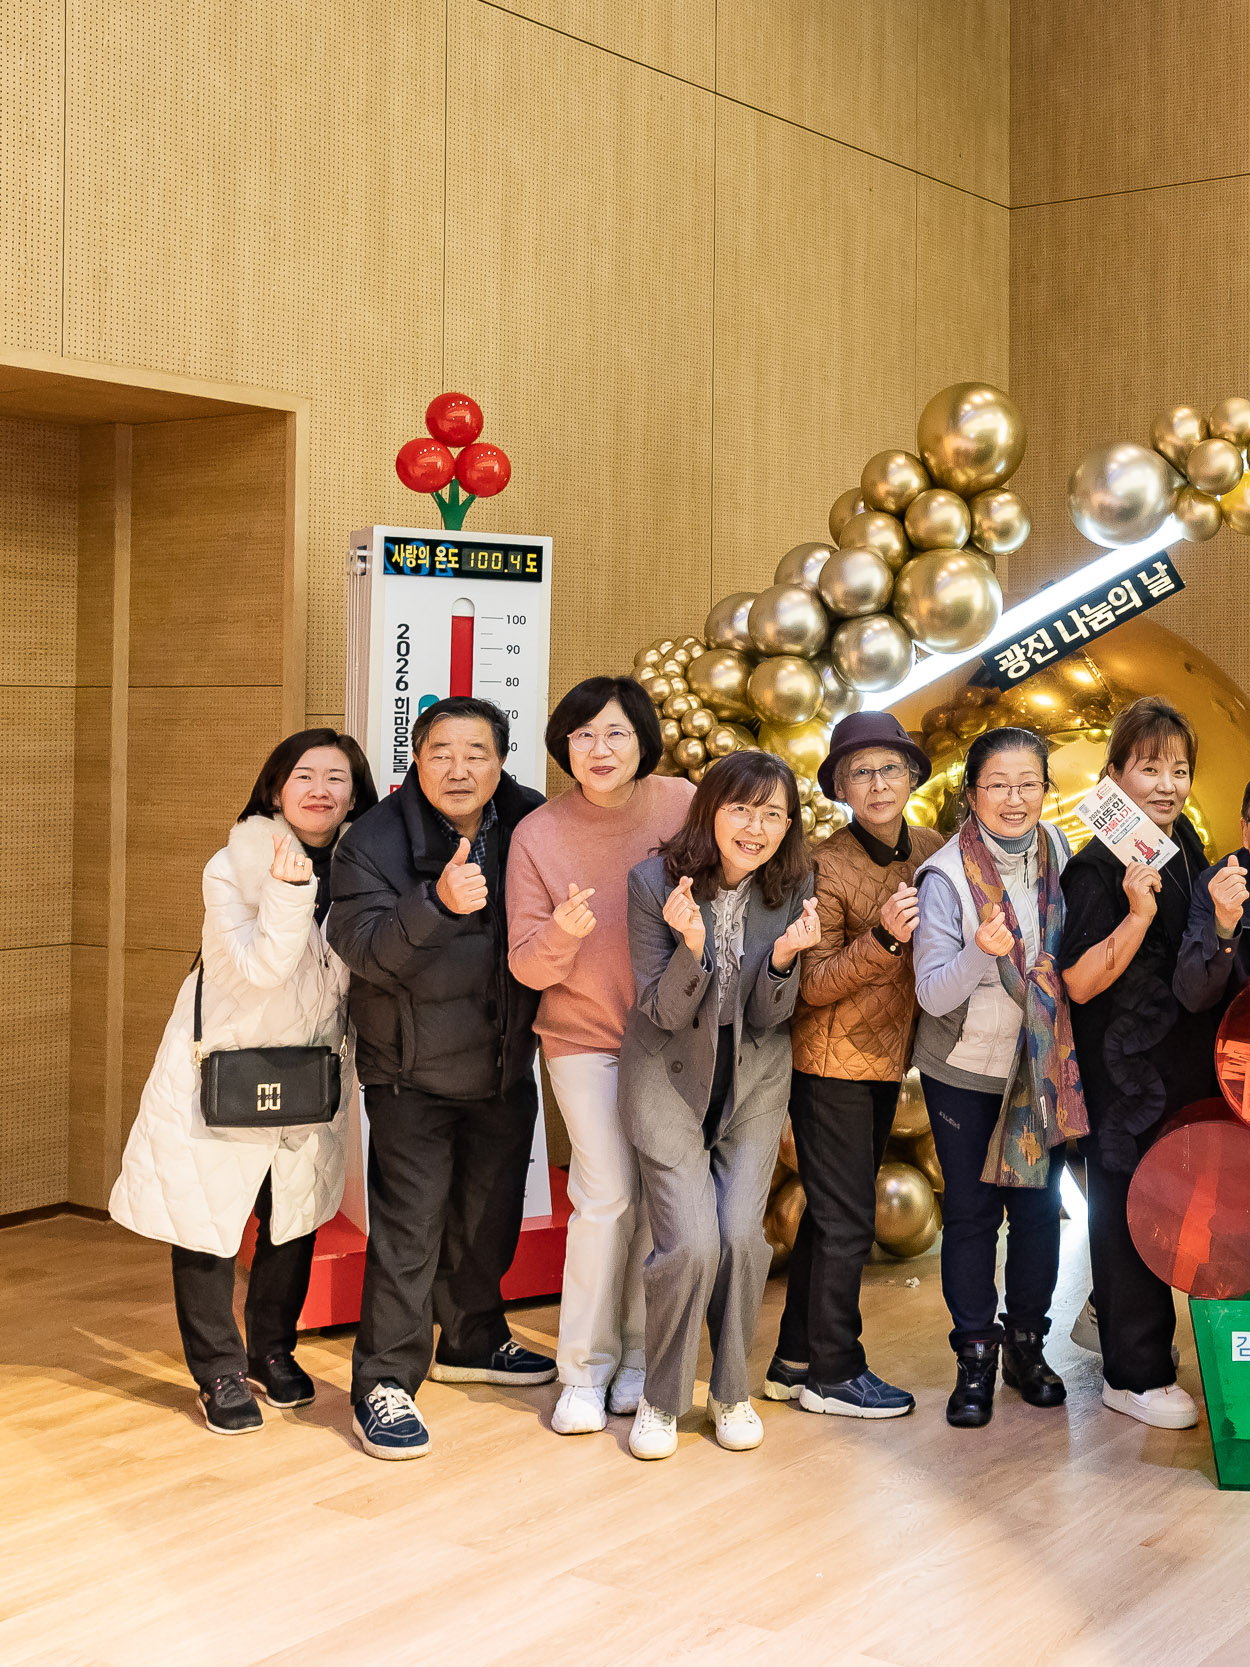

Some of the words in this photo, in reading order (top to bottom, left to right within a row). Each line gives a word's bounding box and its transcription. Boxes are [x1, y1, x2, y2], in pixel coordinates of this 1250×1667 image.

[391, 543, 430, 568] 사랑의
[434, 546, 460, 569] 온도
[470, 551, 521, 573] 100.4
[506, 615, 526, 625] 100
[994, 627, 1058, 679] 광진
[1053, 578, 1143, 644] 나눔의
[1137, 561, 1175, 598] 날
[506, 645, 520, 654] 90
[505, 677, 519, 687] 80
[505, 710, 519, 719] 70
[393, 697, 410, 773] 희망온돌
[1093, 798, 1126, 830] 따뜻한
